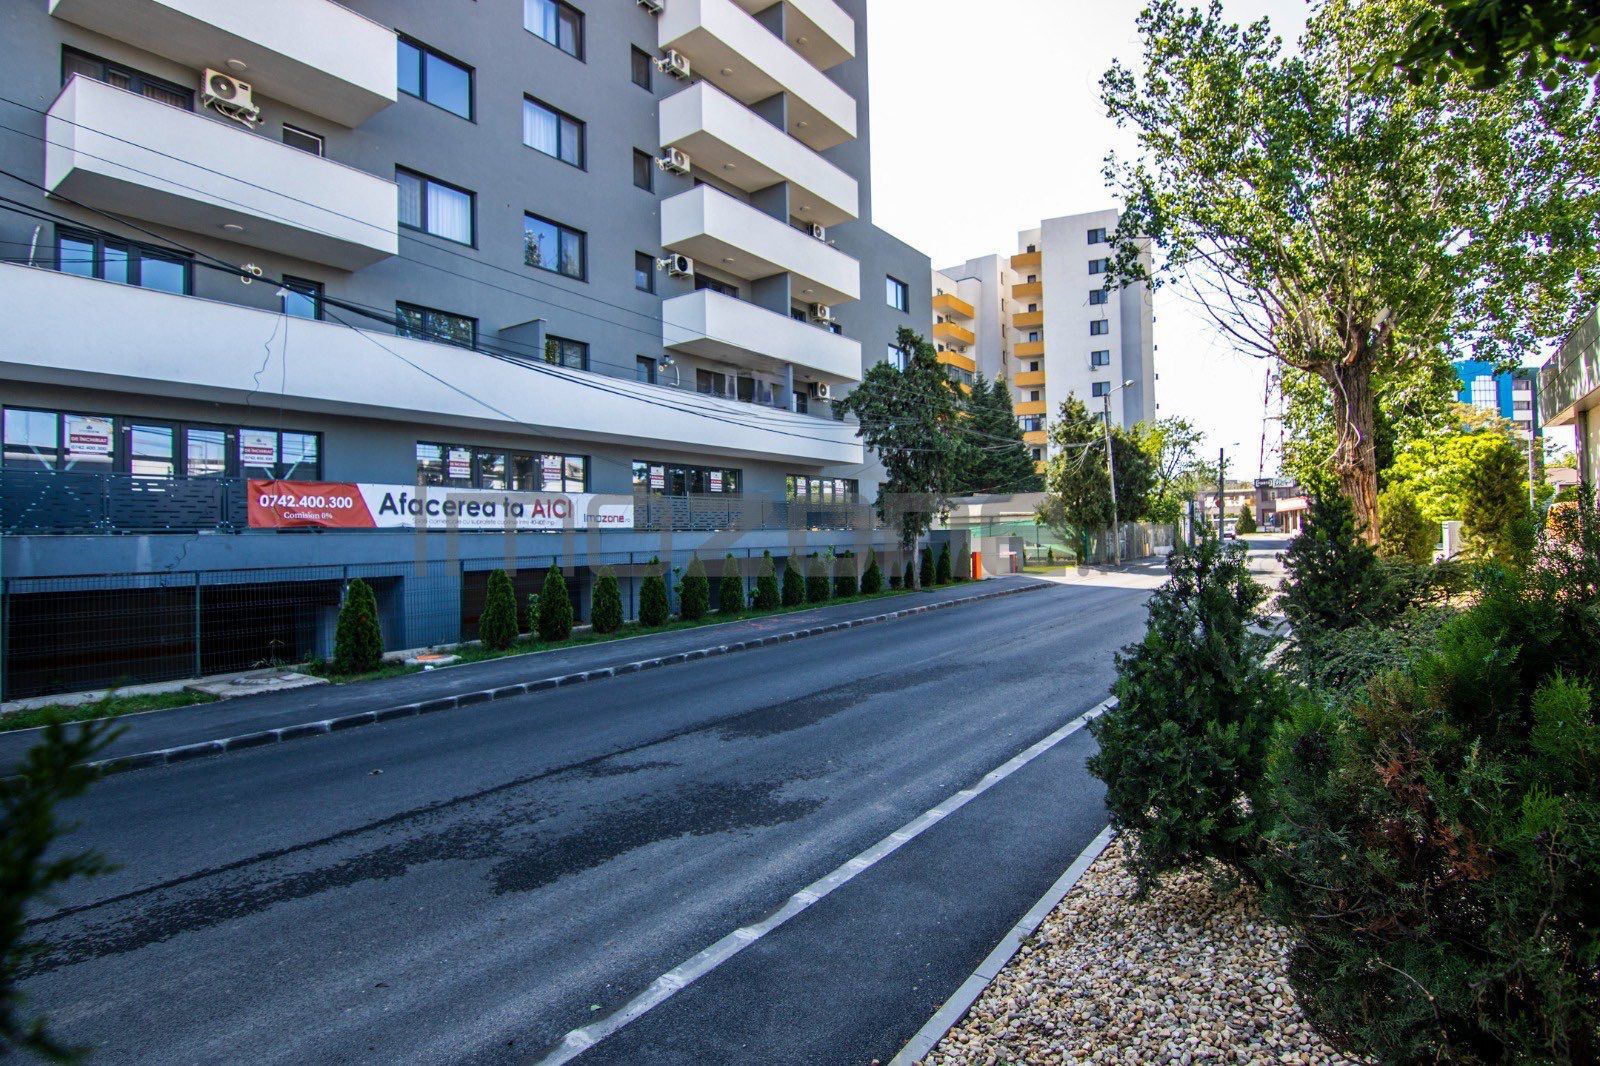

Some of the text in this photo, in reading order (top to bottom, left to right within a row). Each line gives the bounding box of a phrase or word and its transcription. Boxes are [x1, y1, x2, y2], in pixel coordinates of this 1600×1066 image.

[259, 495, 353, 509] 0742.400.300
[378, 492, 572, 519] Afacerea ta AICI
[283, 511, 320, 519] Comision
